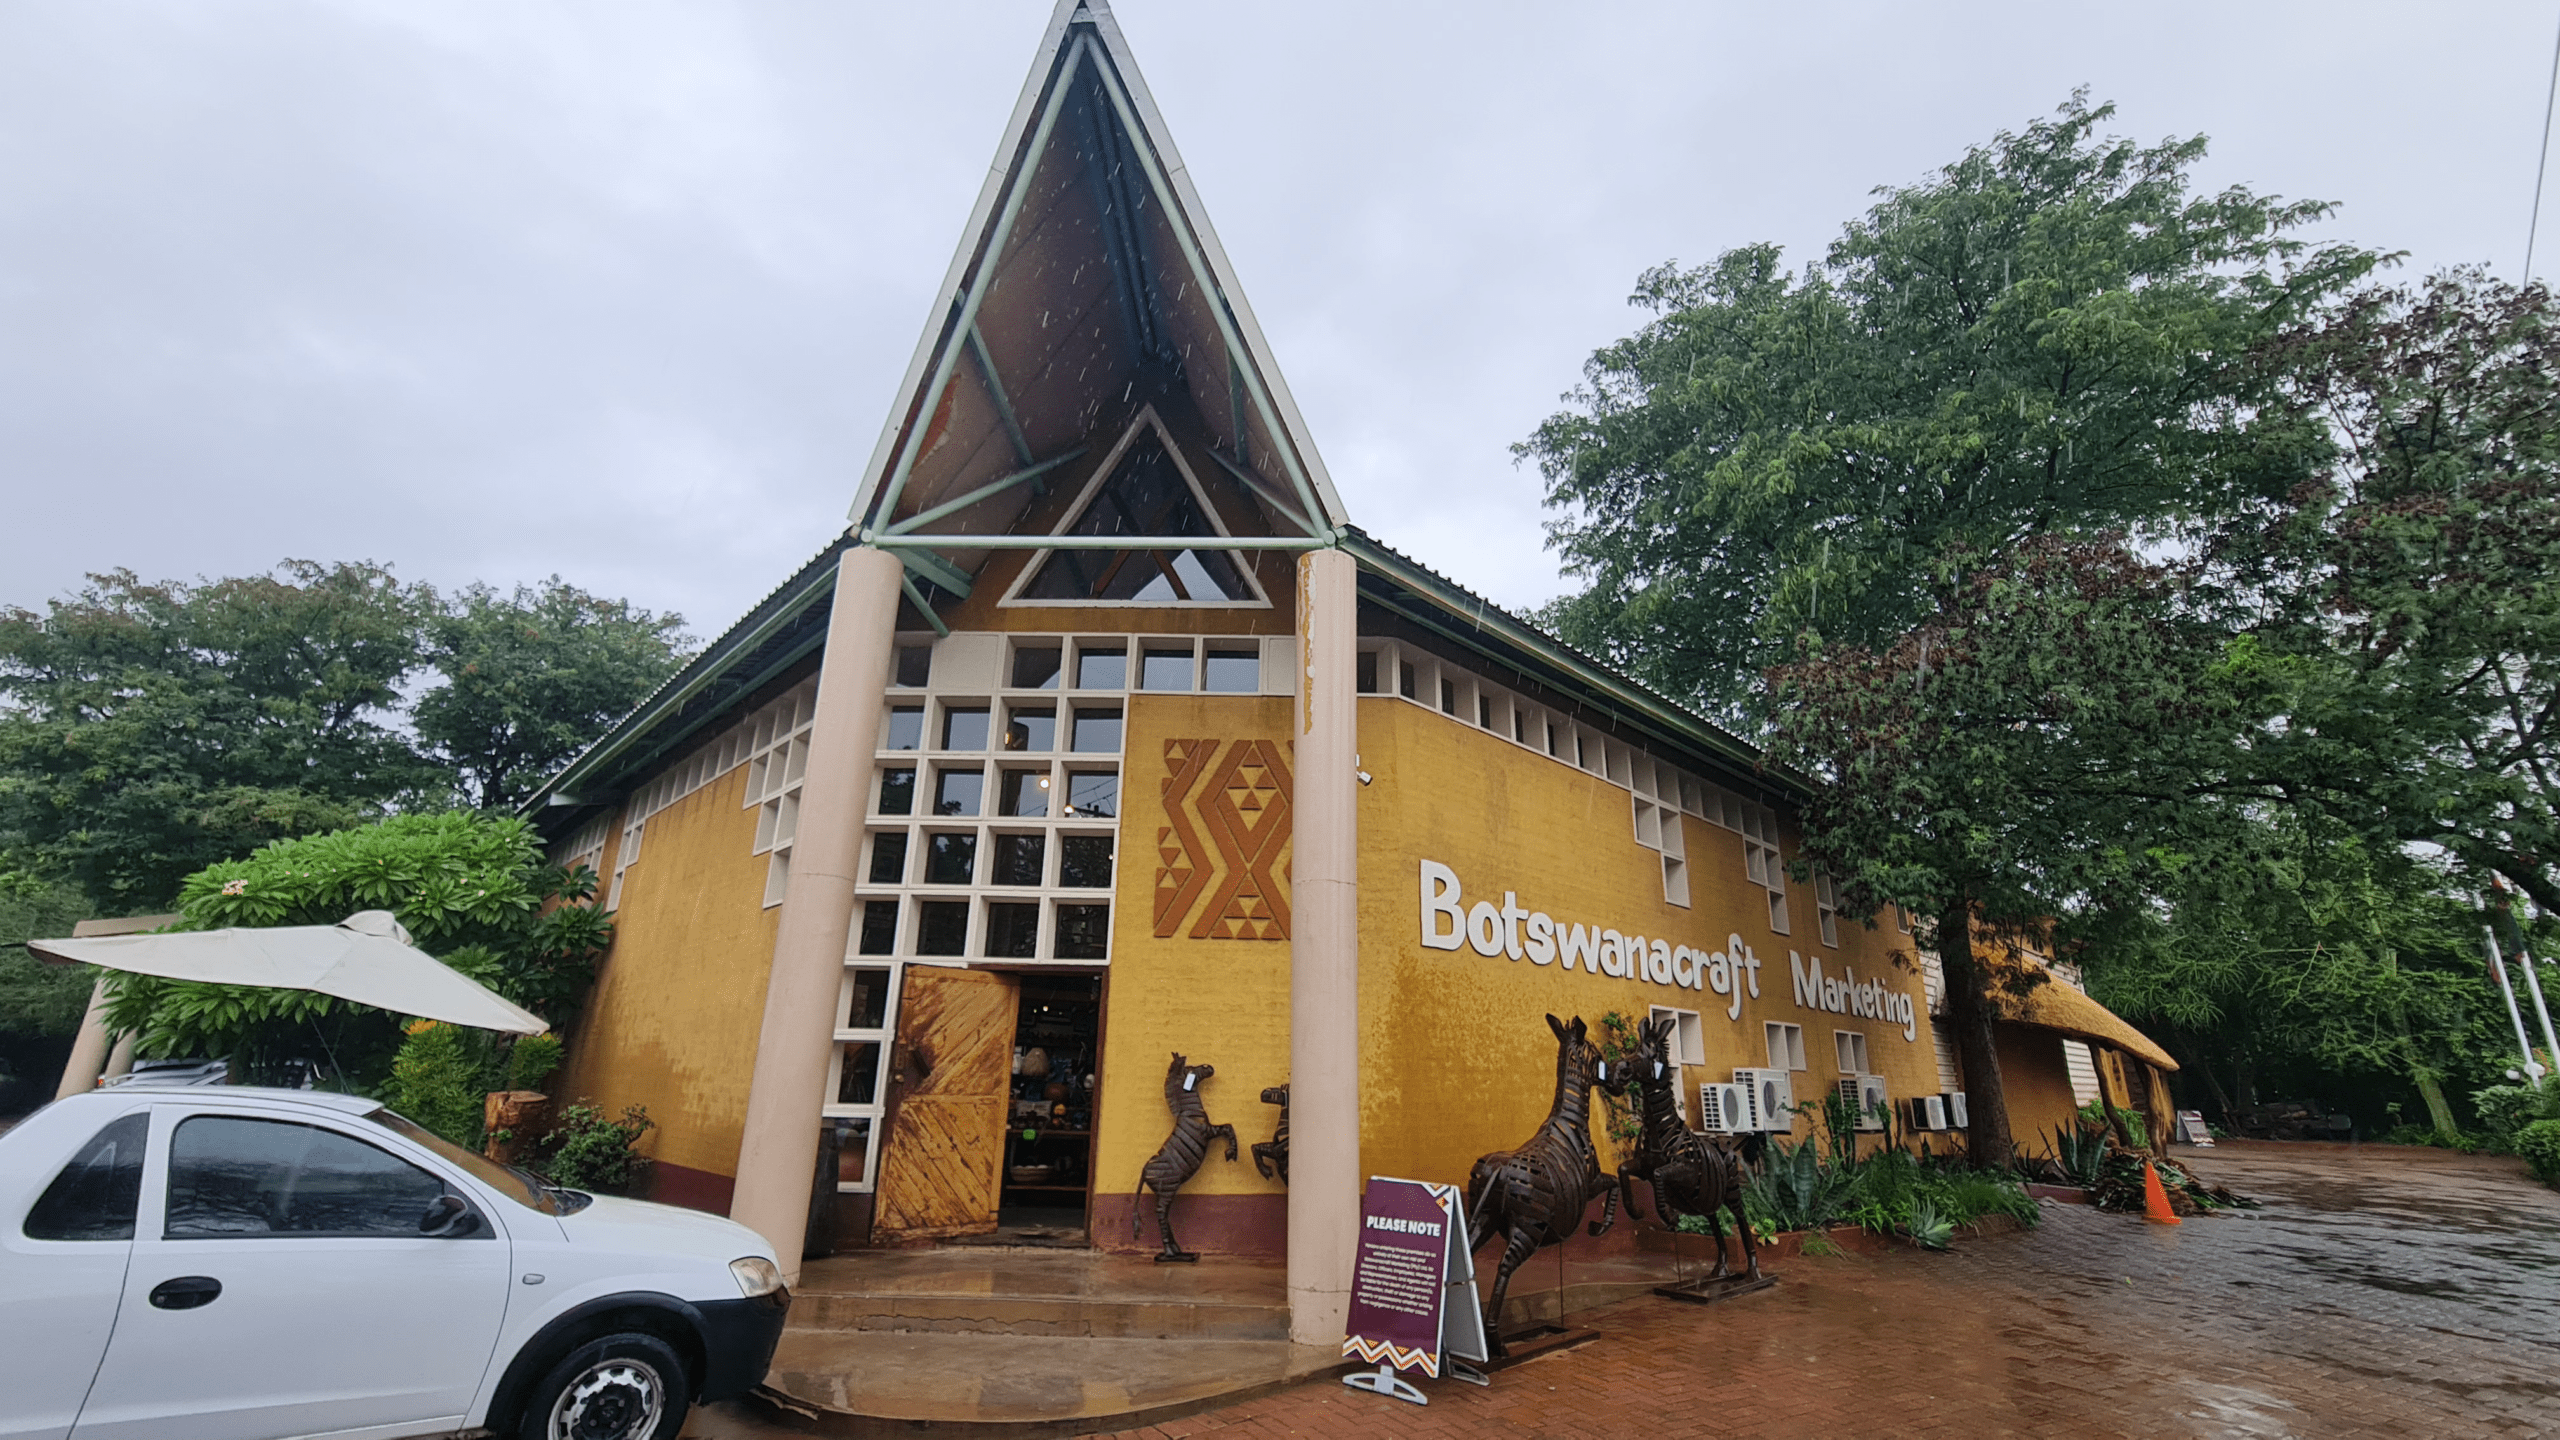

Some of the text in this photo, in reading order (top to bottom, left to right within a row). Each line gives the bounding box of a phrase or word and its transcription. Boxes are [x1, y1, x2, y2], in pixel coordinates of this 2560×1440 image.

[1420, 859, 1916, 1042] Botswanacraft Marketing
[1366, 1215, 1441, 1237] PLEASE NOTE
